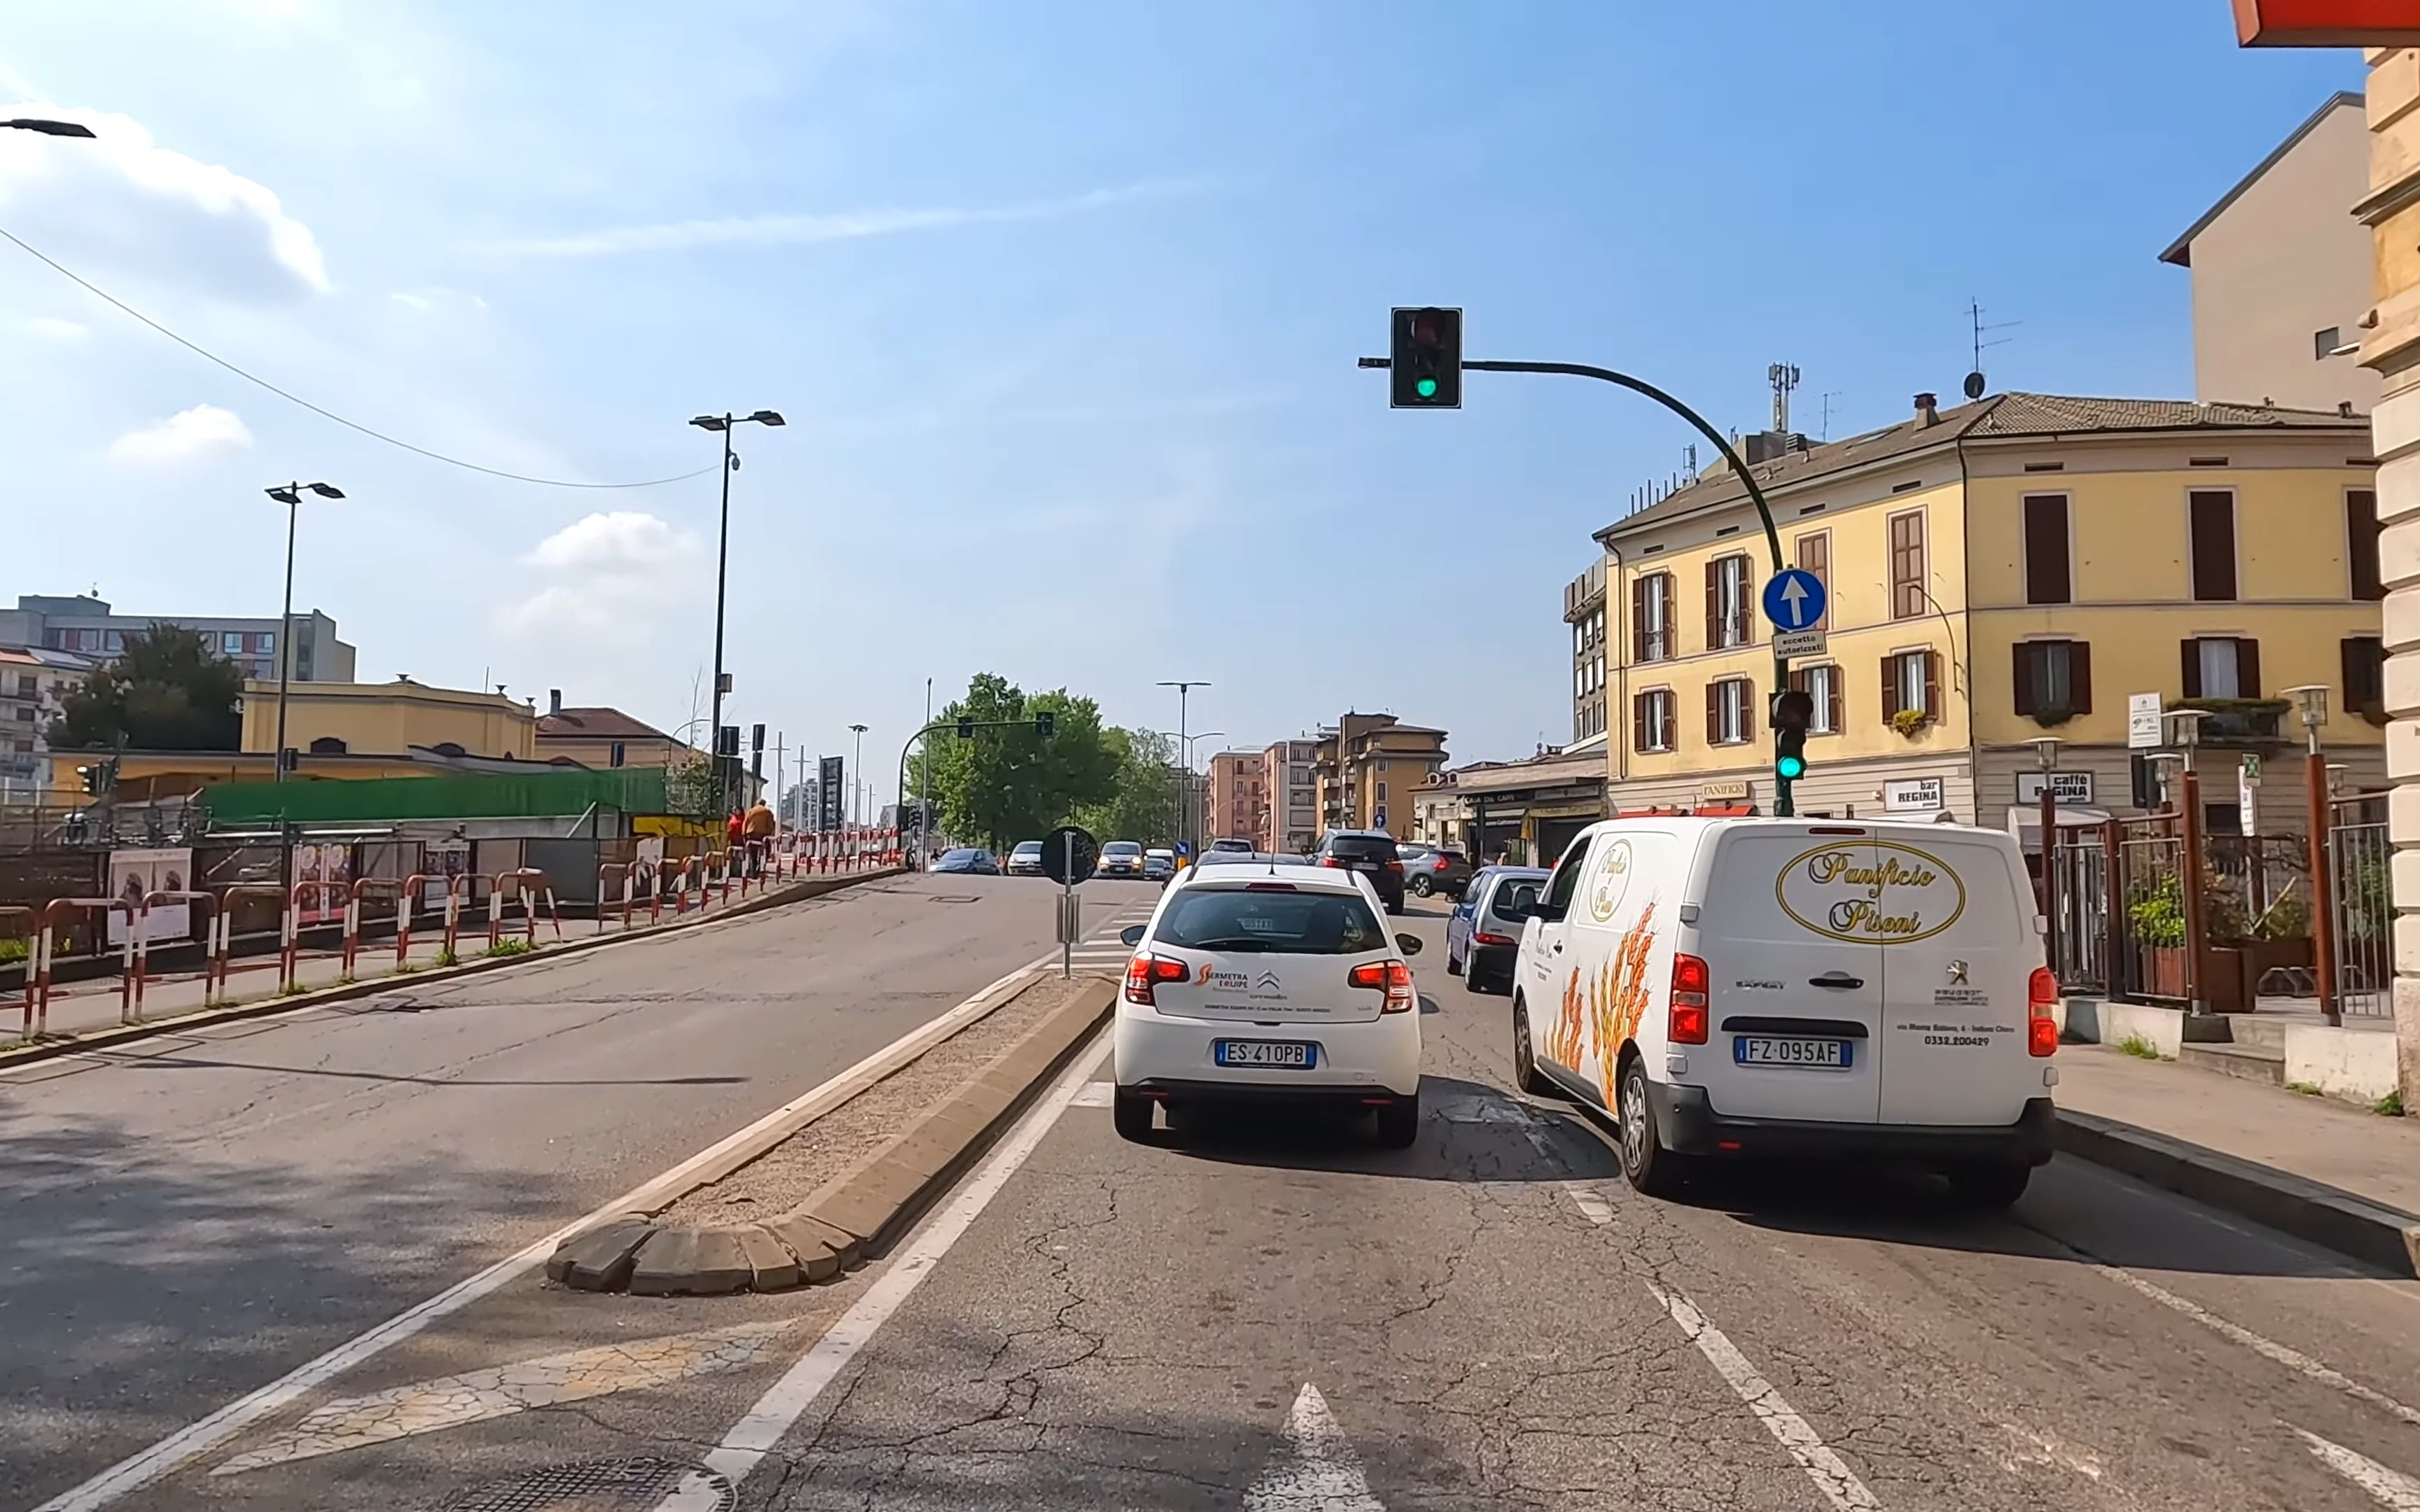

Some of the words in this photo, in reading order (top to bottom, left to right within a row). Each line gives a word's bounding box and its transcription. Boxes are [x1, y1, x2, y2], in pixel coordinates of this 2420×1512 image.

[1783, 636, 1816, 645] eccetto
[1777, 644, 1823, 654] autorizzati
[1921, 780, 1938, 790] bar
[2054, 774, 2087, 785] caffè
[1704, 784, 1744, 795] PANIFICIO
[2034, 786, 2087, 796] RGINA
[1898, 791, 1938, 802] REGINA
[1809, 852, 1936, 895] Panificio
[1829, 899, 1921, 934] Pisoni
[1228, 1044, 1248, 1060] ES
[1253, 1044, 1304, 1063] 410PB
[1749, 1040, 1772, 1060] FZ
[1779, 1042, 1838, 1062] 095AF
